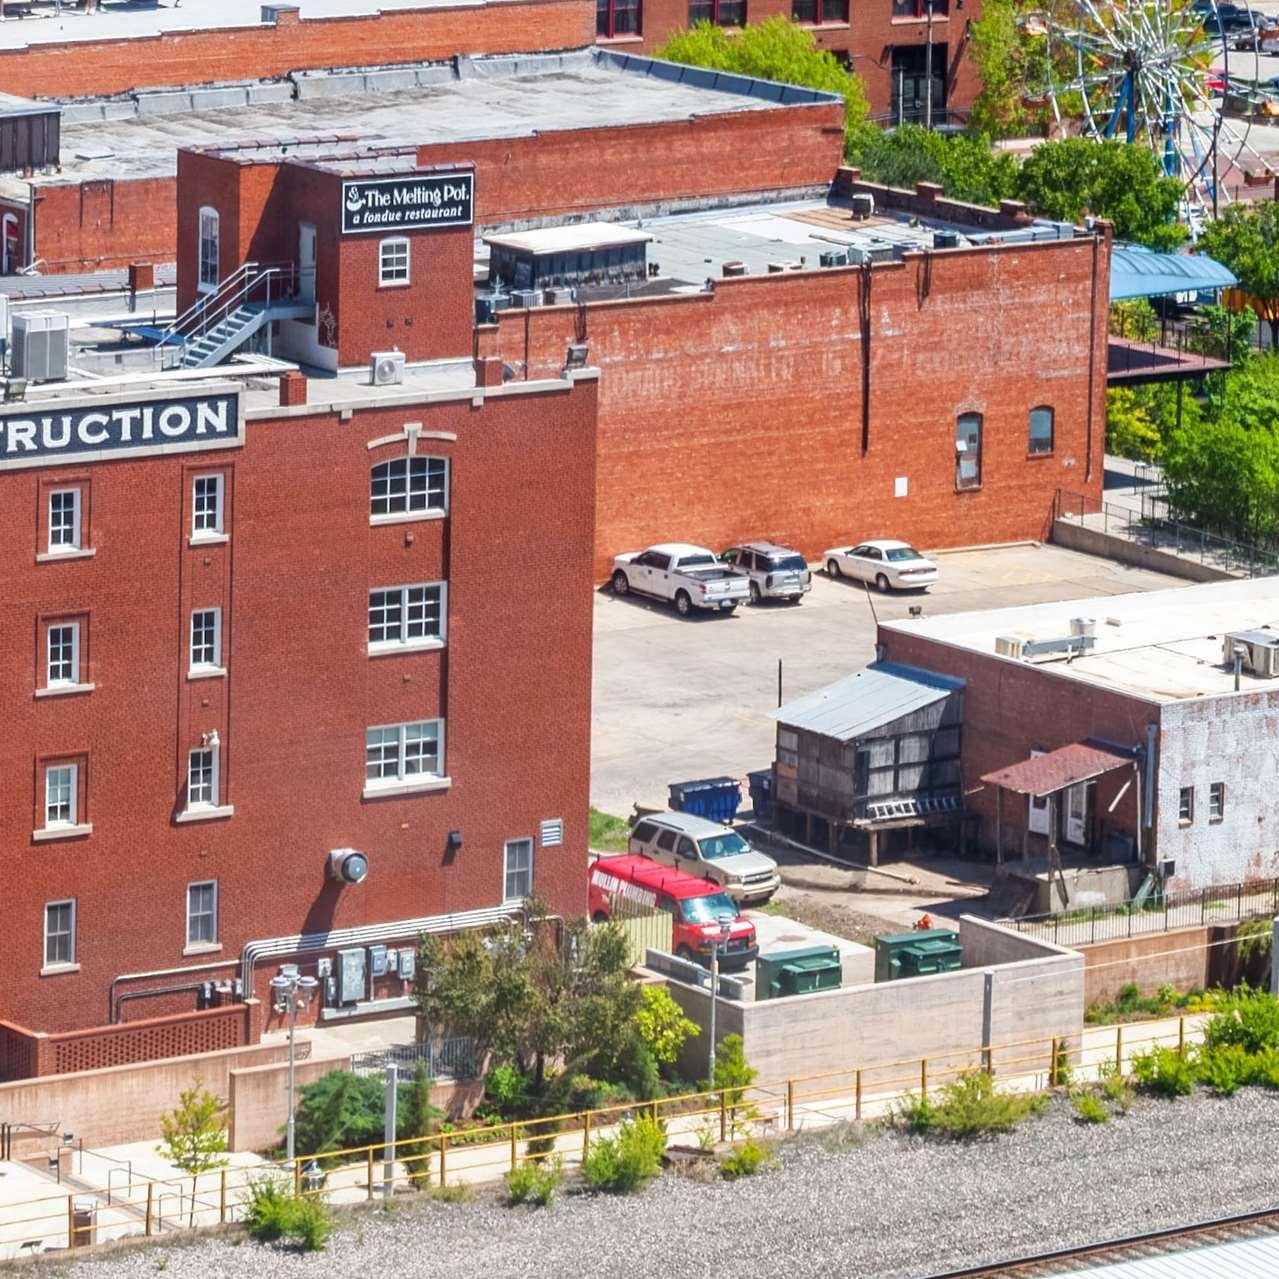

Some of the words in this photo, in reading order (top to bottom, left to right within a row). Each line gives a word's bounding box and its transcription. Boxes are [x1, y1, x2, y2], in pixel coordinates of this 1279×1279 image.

[364, 188, 391, 208] The
[393, 185, 441, 207] Melting
[352, 215, 361, 224] a
[363, 209, 402, 224] fondue
[404, 205, 463, 221] restaurant
